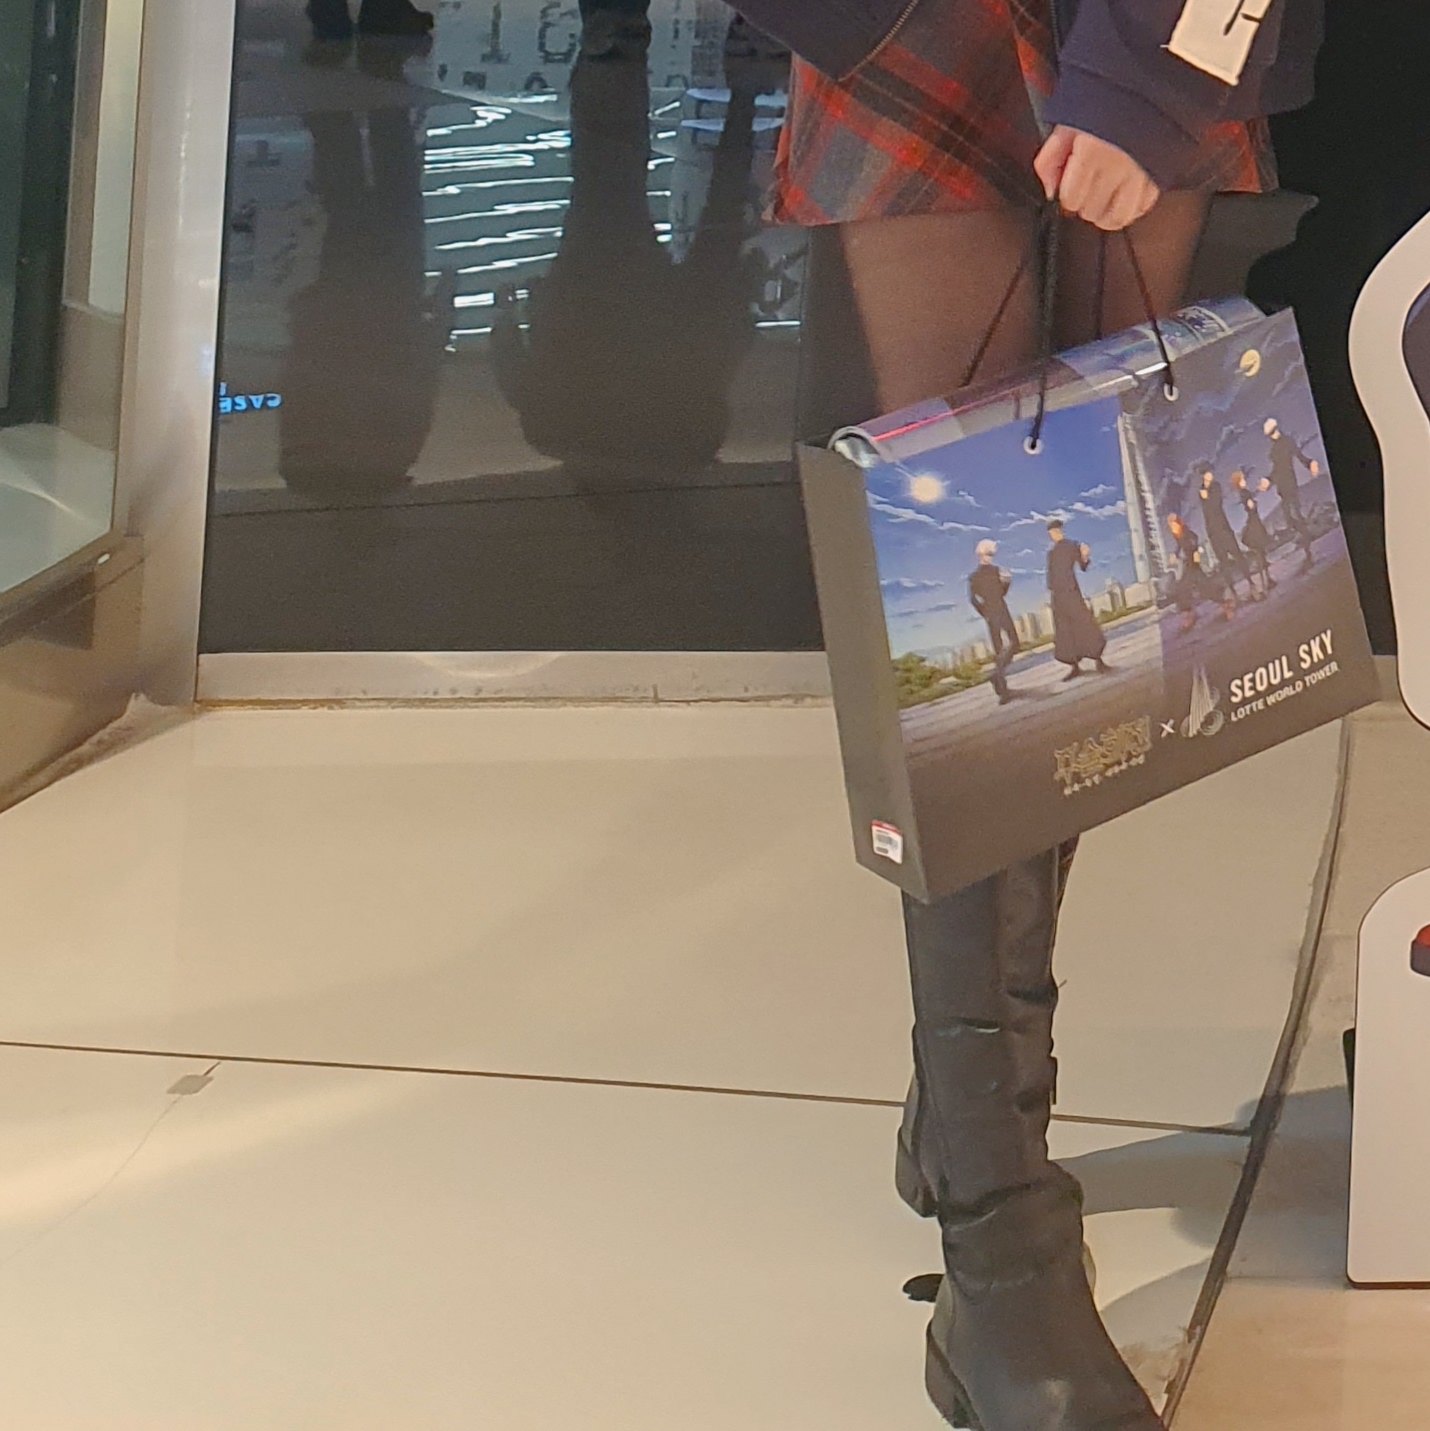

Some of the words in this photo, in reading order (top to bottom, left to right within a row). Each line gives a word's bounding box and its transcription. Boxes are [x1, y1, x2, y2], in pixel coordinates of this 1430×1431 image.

[1230, 655, 1294, 703] SEOUL
[1298, 628, 1333, 670] SKY
[1230, 697, 1265, 722] LOTTE
[1266, 680, 1303, 707] WORLD
[1304, 661, 1339, 687] TOWER
